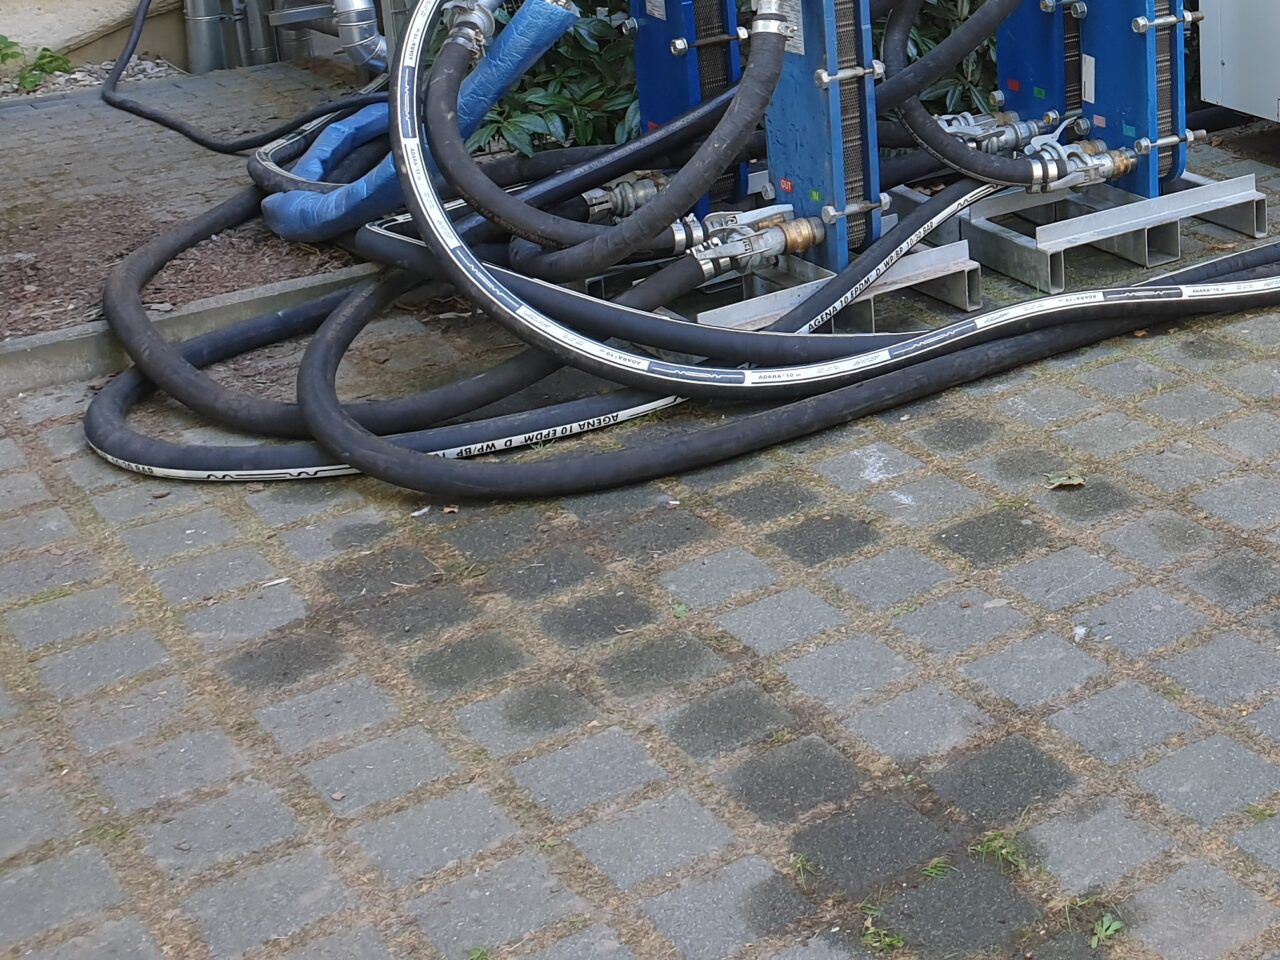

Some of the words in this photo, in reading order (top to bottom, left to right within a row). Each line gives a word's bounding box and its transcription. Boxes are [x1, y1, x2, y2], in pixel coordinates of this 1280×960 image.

[808, 306, 838, 332] AGENA
[840, 296, 849, 308] 10
[875, 267, 881, 277] D
[922, 221, 934, 234] BAR
[577, 412, 620, 431] AGENA
[561, 425, 573, 435] 10
[456, 443, 497, 457] WP/BP
[504, 439, 512, 447] D
